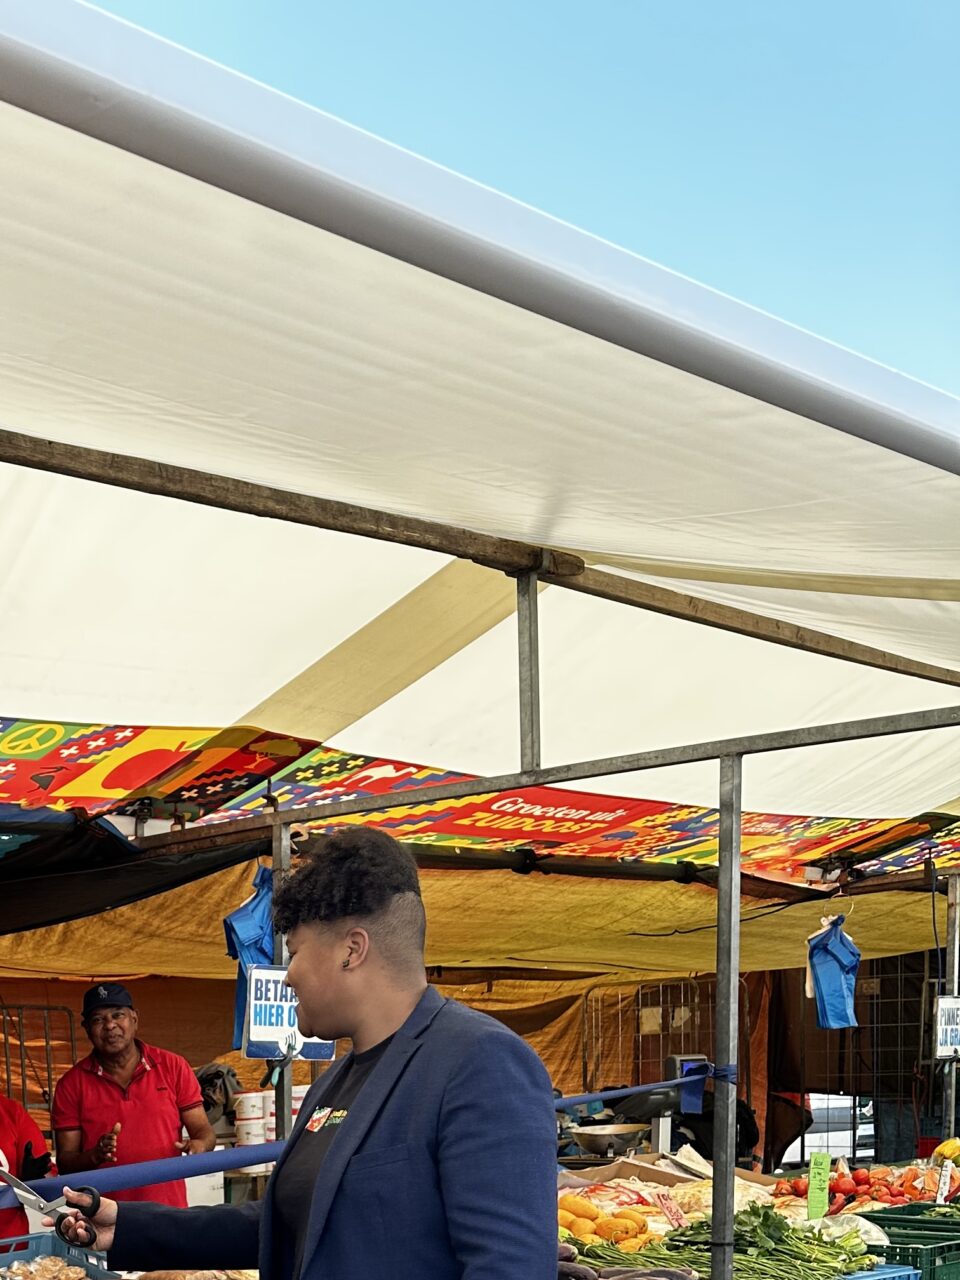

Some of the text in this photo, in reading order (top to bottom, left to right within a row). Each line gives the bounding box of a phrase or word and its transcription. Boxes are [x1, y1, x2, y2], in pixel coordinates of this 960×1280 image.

[490, 797, 628, 821] Groeten uit
[452, 811, 610, 834] ZUIDOOST
[254, 978, 299, 1003] BETAA
[253, 1003, 297, 1028] HIER O
